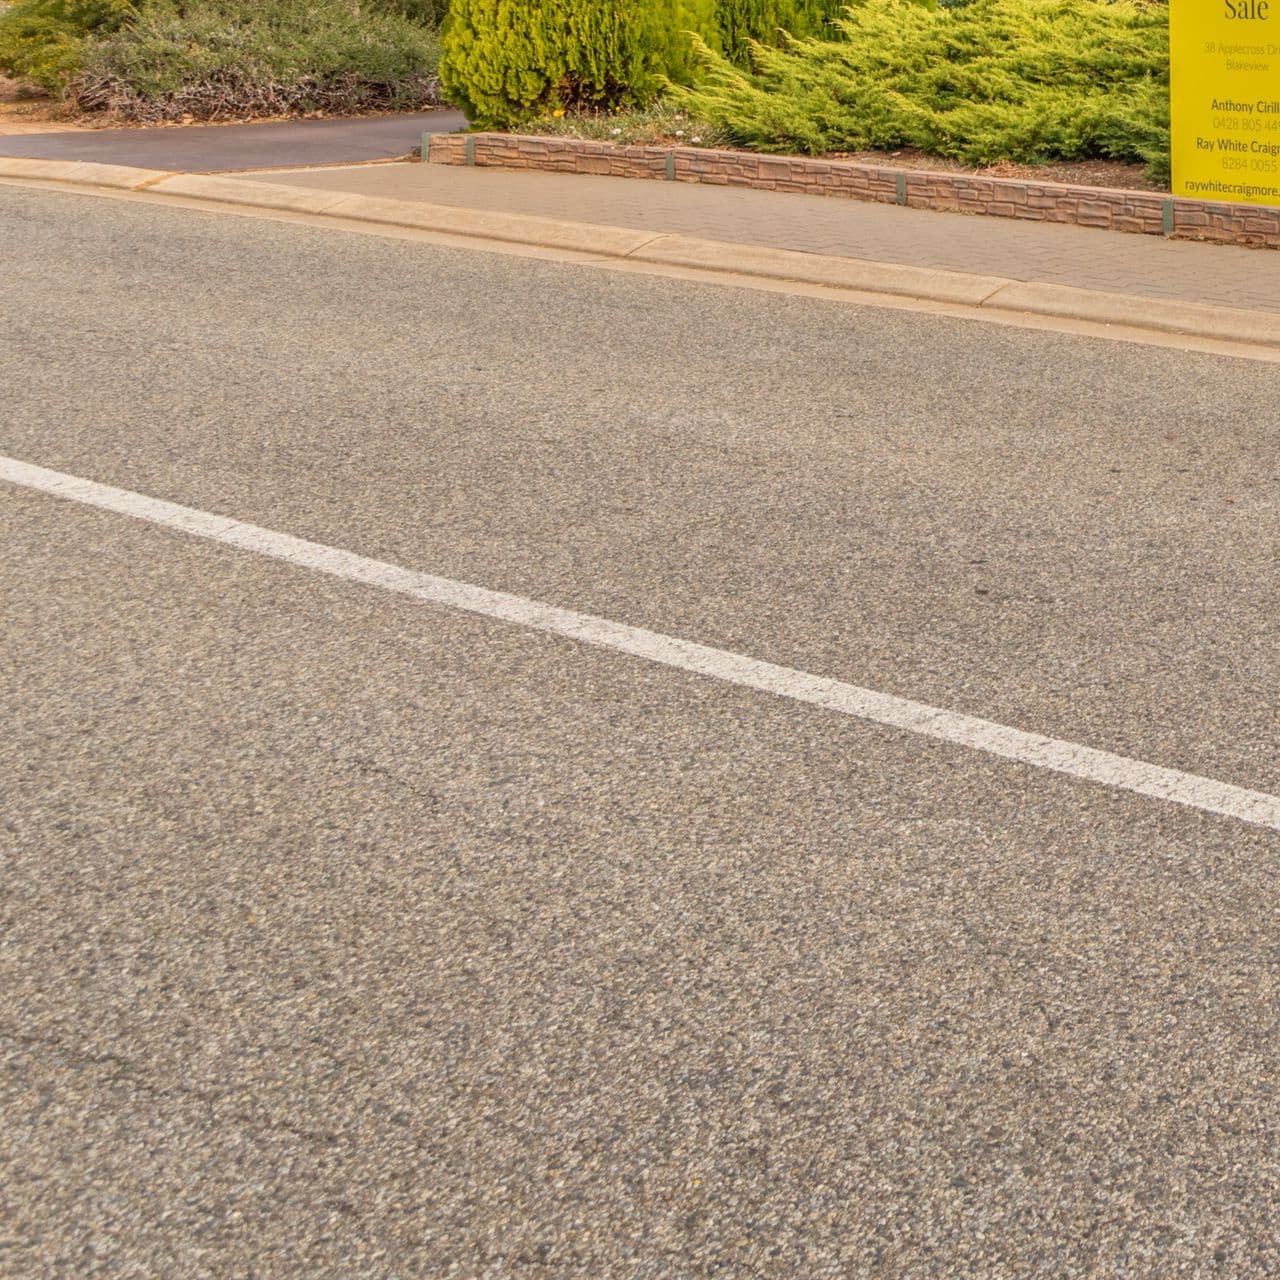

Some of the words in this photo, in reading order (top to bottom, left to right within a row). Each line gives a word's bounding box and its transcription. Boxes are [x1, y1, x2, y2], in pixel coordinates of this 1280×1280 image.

[1218, 43, 1265, 56] Applecross
[1226, 58, 1270, 72] Blakeview
[1211, 99, 1254, 114] Anthony
[1212, 117, 1239, 130] 0428
[1242, 119, 1261, 132] 805
[1196, 137, 1215, 152] Ray
[1217, 139, 1248, 152] White
[1221, 157, 1248, 171] 8284
[1250, 159, 1278, 173] 0055
